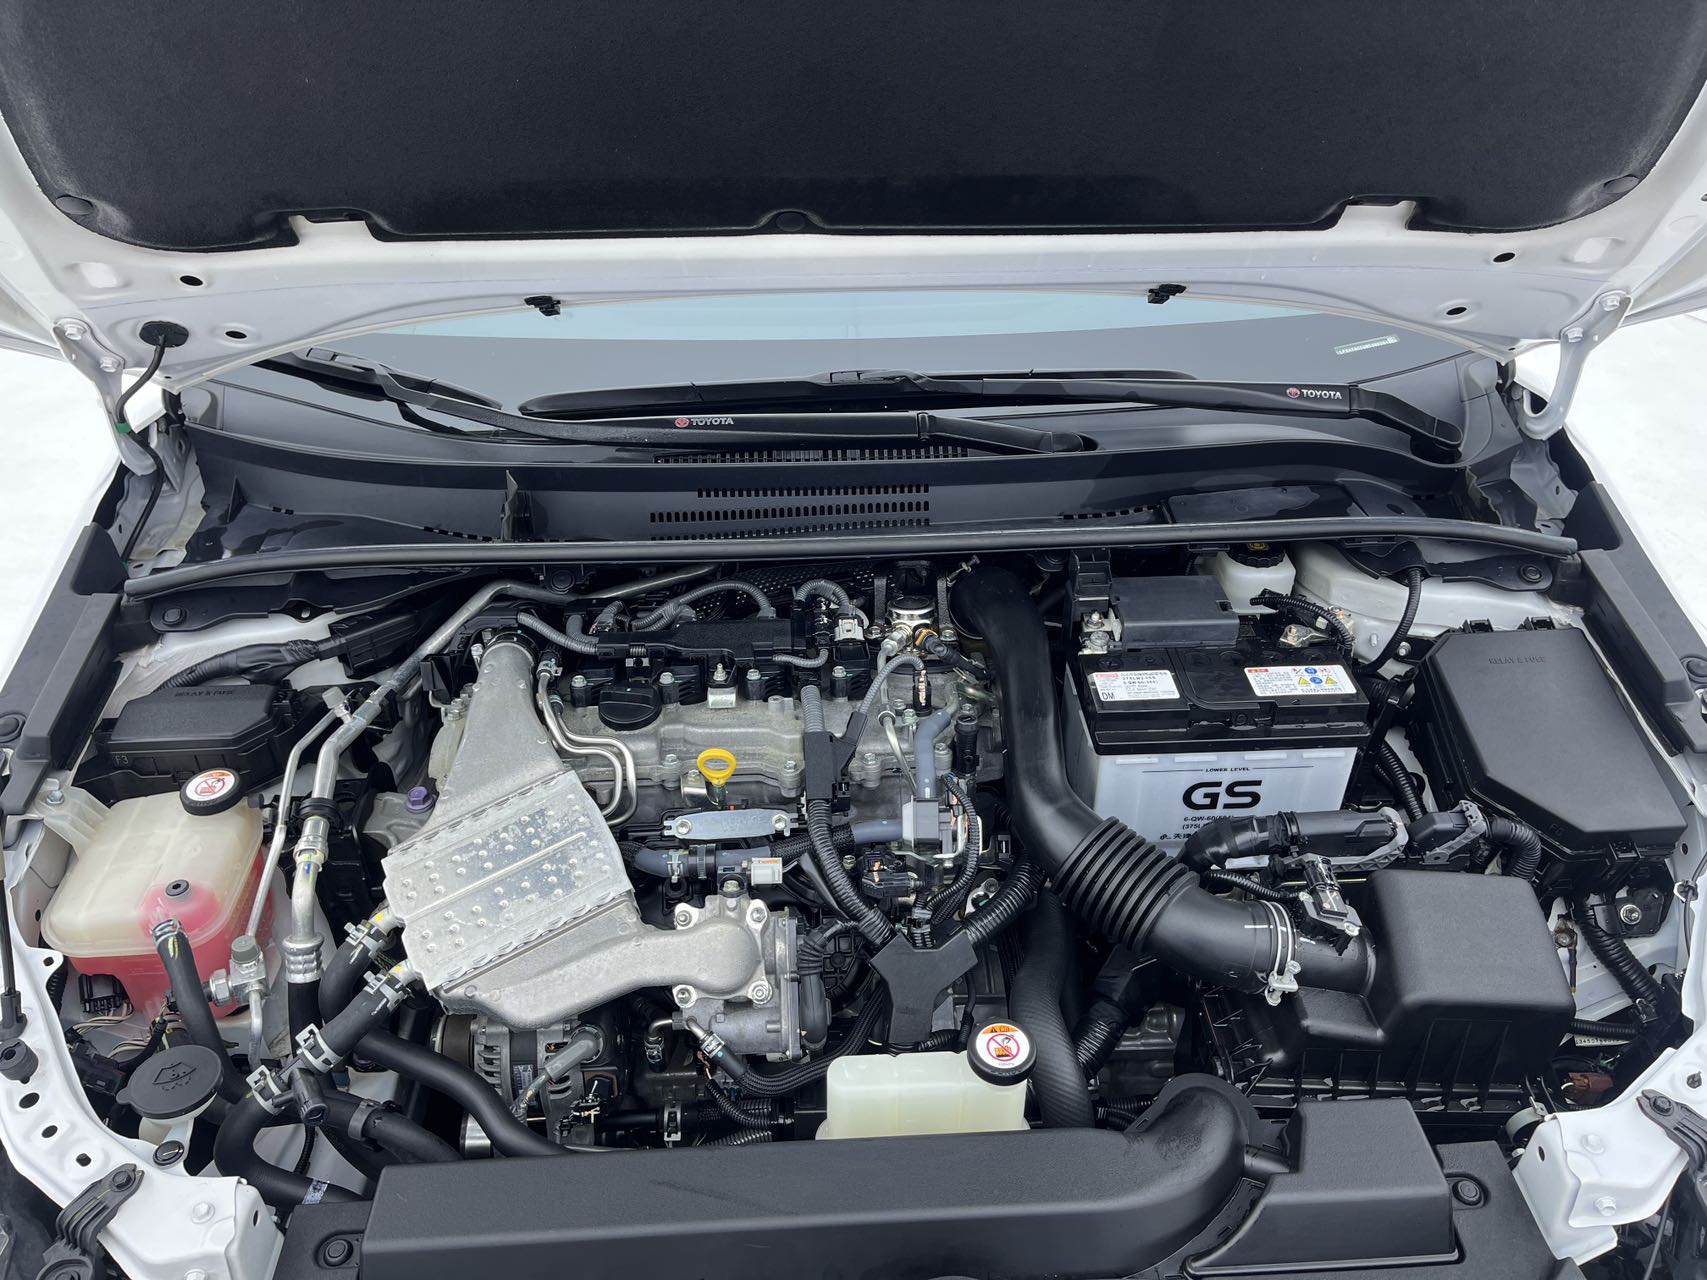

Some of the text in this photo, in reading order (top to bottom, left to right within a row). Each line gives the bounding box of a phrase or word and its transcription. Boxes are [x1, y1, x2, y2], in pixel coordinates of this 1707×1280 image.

[1301, 389, 1343, 400] TOYOTA
[690, 417, 735, 426] TOYOTA
[1182, 780, 1263, 811] GS
